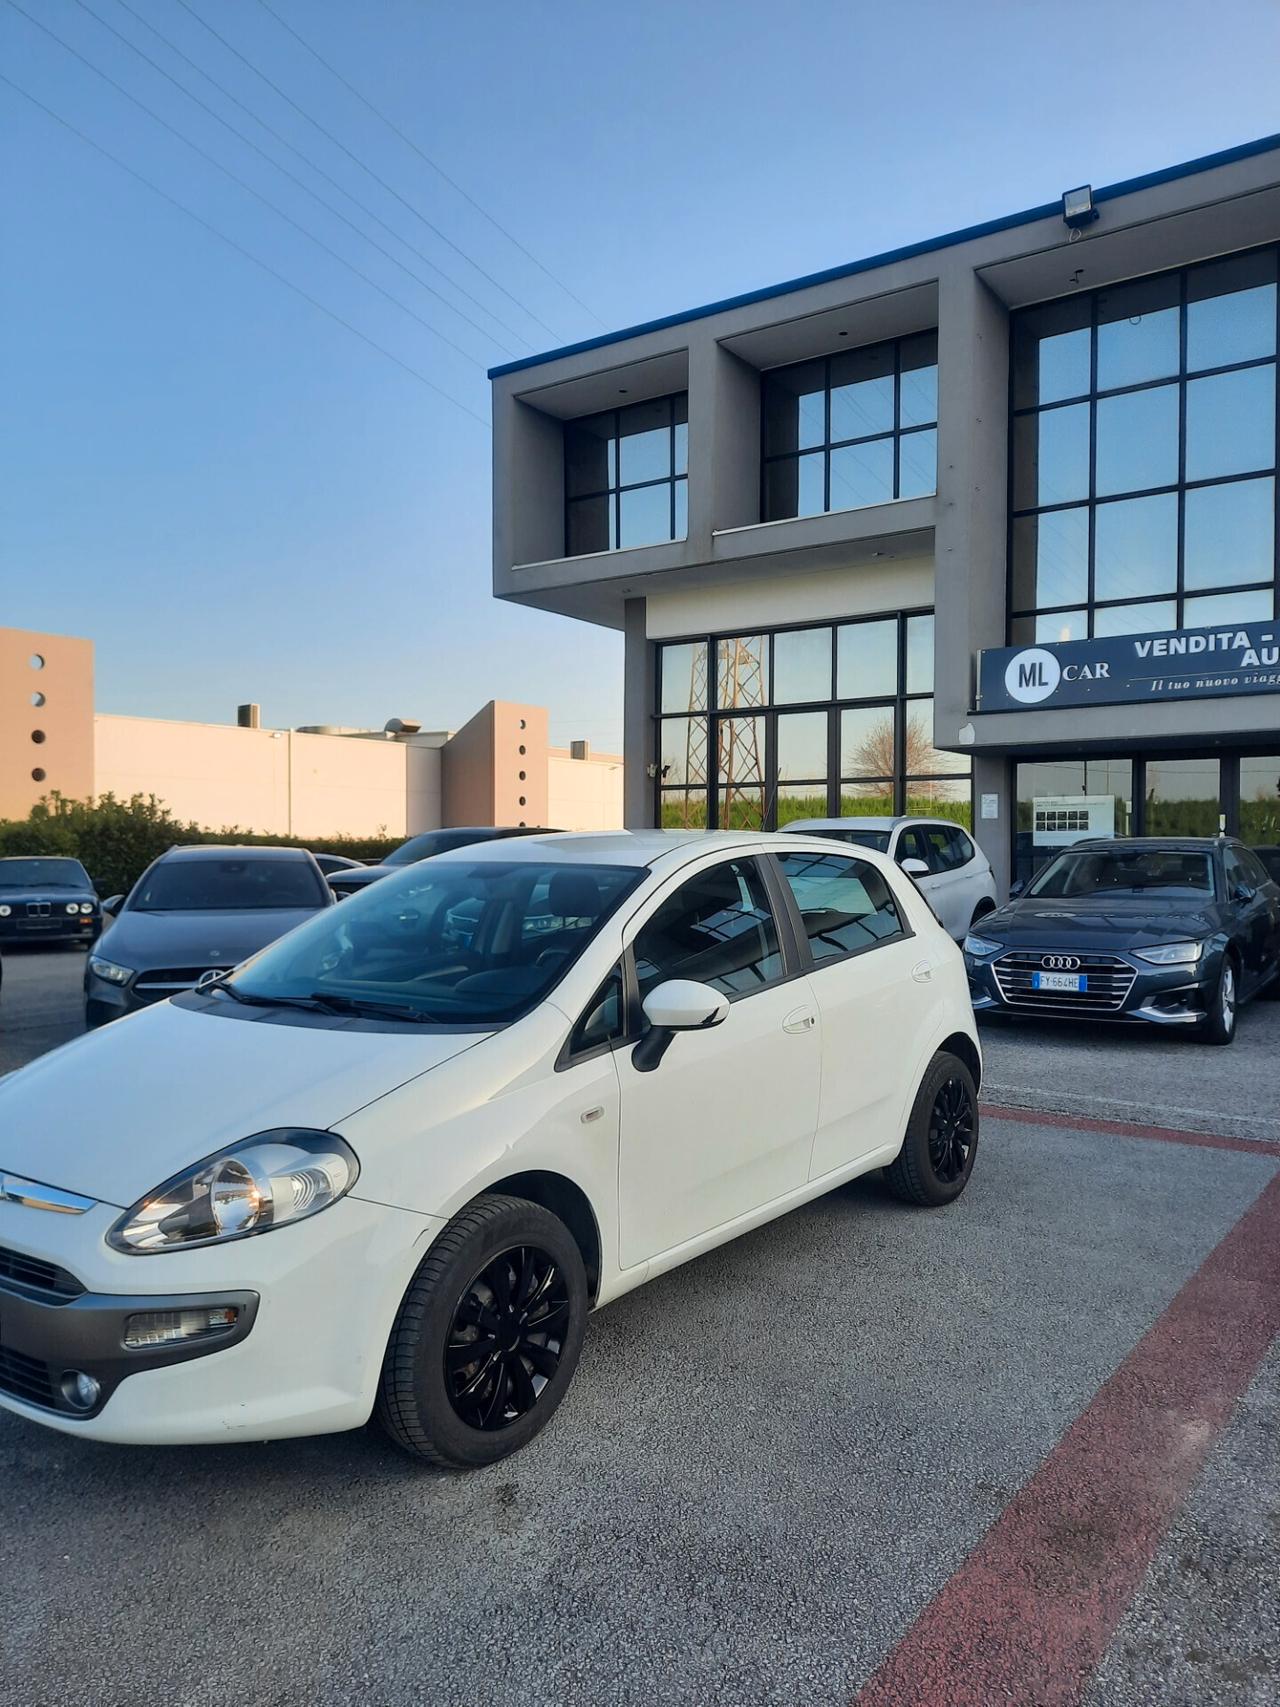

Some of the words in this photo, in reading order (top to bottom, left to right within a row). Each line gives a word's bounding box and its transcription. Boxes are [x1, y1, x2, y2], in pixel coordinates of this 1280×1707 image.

[1134, 631, 1251, 658] VENDITA
[1240, 646, 1279, 667] AU
[1018, 662, 1049, 688] ML
[1062, 662, 1110, 681] CAR
[1150, 680, 1163, 691] Il
[1167, 680, 1190, 690] tuo
[1195, 677, 1239, 688] nuovo
